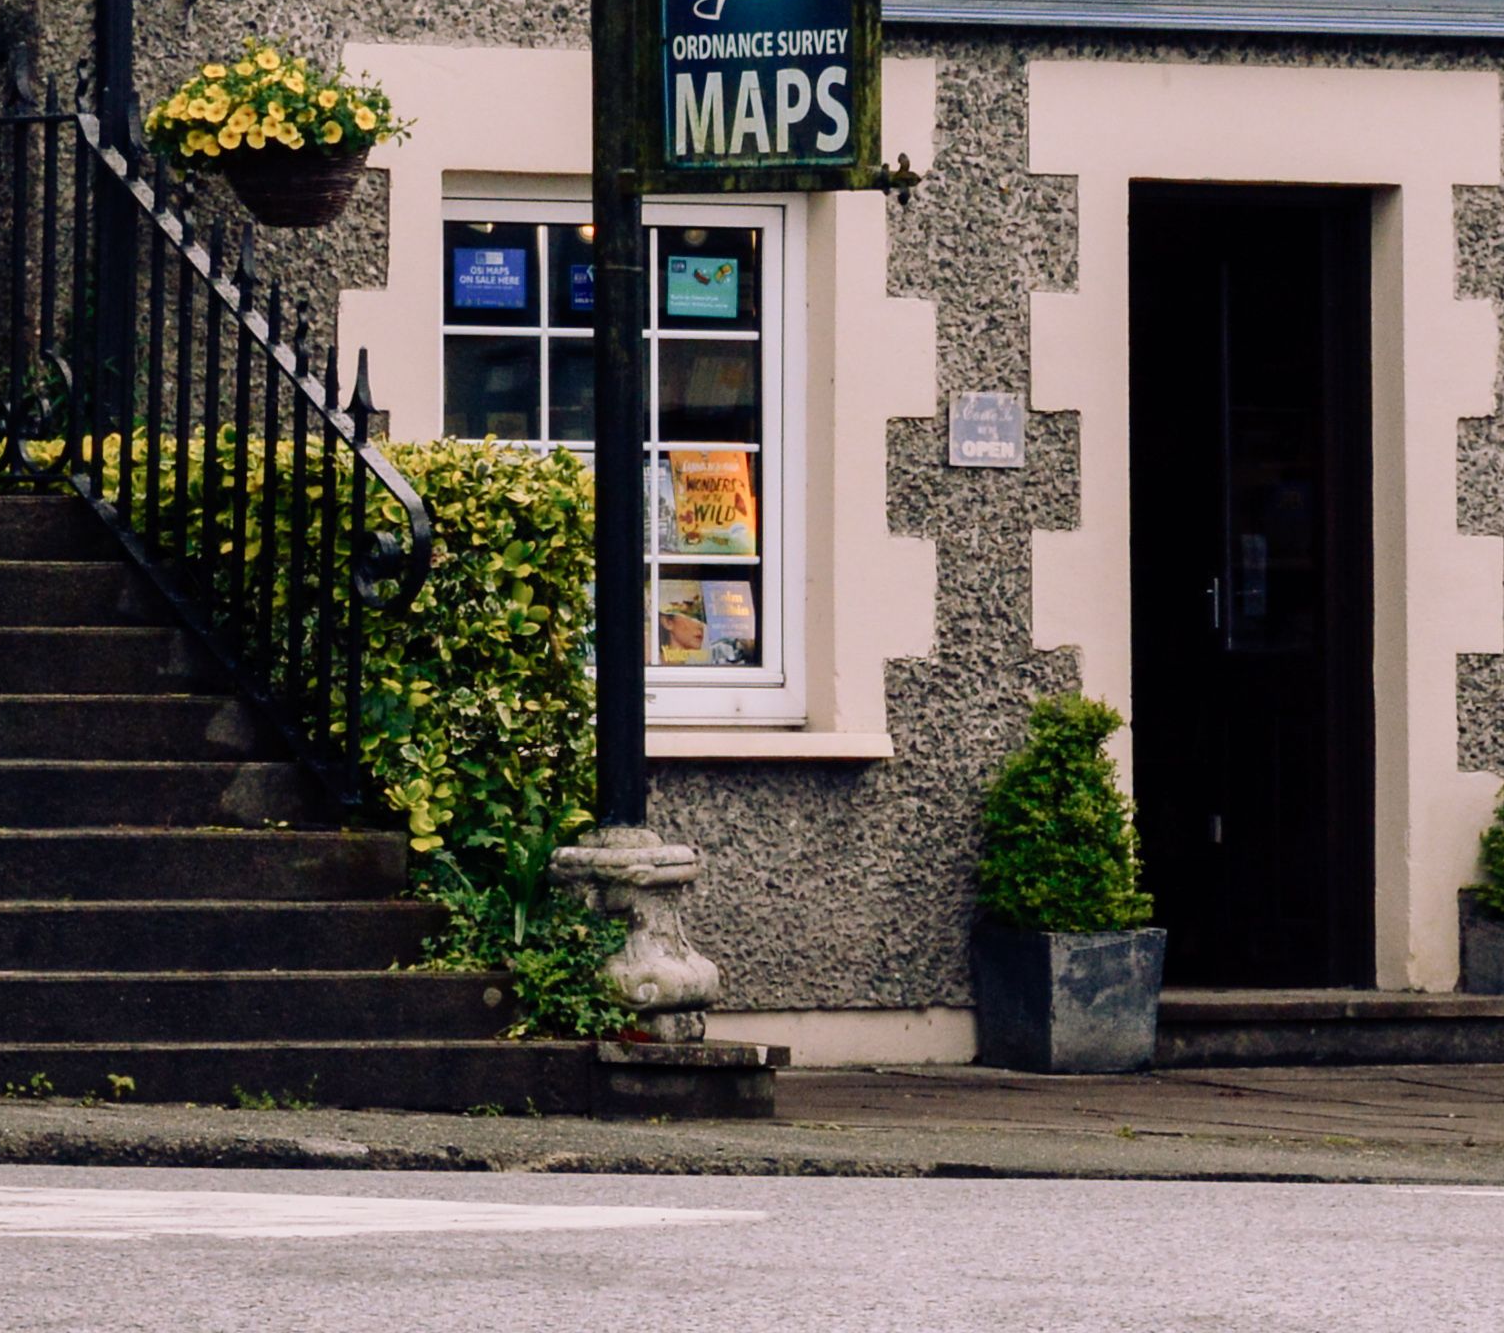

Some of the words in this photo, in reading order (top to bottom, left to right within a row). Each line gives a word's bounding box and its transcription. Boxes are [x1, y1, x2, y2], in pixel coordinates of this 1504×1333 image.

[672, 31, 774, 62] ORDNANCE
[776, 28, 849, 57] SURVEY
[675, 66, 850, 156] MAPS
[486, 266, 510, 276] MAPS
[459, 275, 473, 284] ON
[475, 275, 497, 285] SALE
[498, 276, 520, 286] HERE
[962, 440, 1015, 458] OPEN
[686, 475, 737, 493] WONDERS
[694, 502, 736, 526] WILD
